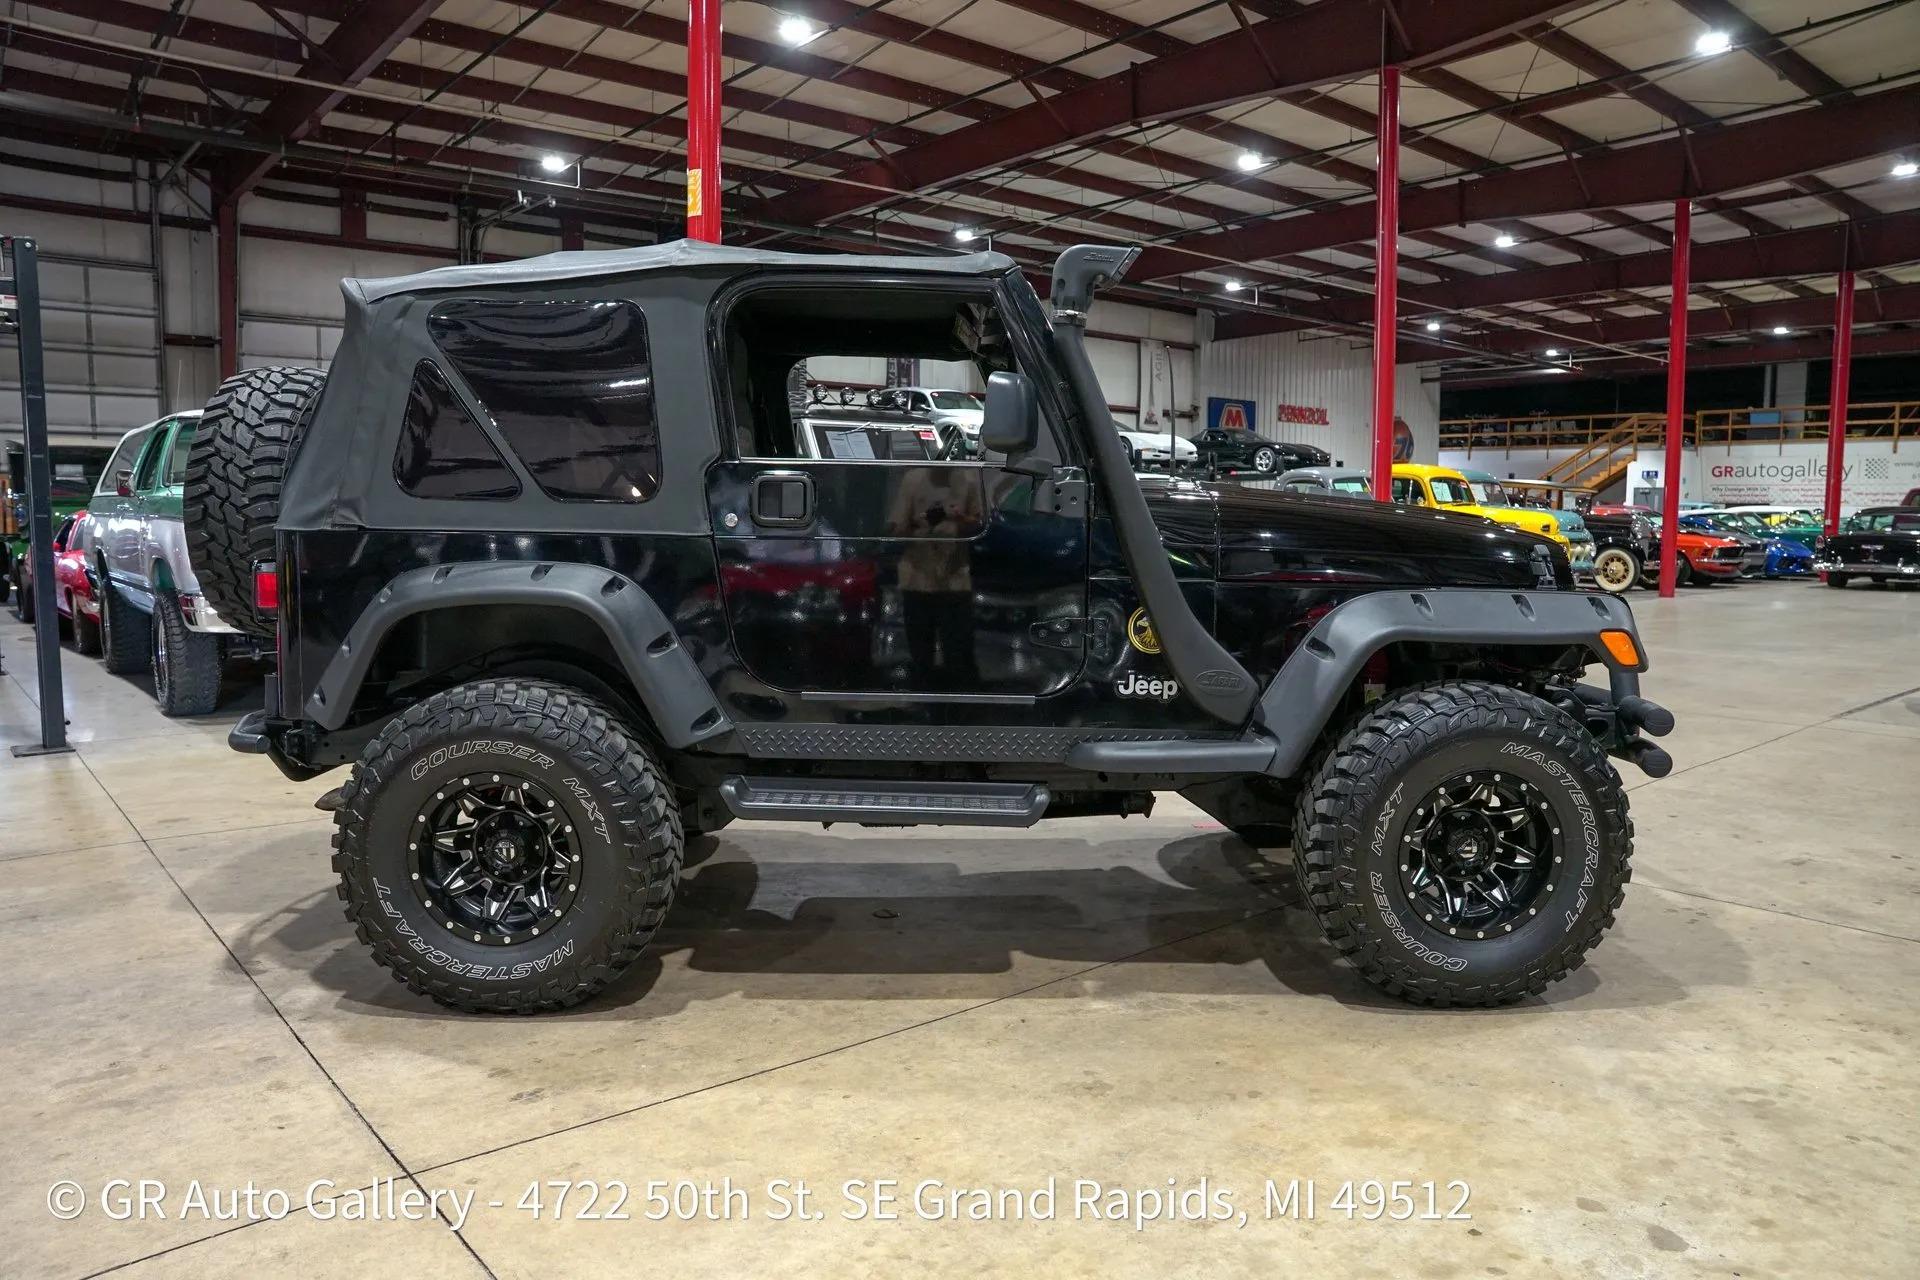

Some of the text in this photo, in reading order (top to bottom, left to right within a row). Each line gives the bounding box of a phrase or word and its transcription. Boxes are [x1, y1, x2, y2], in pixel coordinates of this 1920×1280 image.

[1224, 408, 1244, 427] M
[1711, 458, 1853, 483] GRautogalley
[1117, 671, 1178, 699] Jeep
[411, 740, 611, 844] COURSER MXT
[1501, 741, 1600, 932] MASTERCRAFT
[373, 877, 574, 980] MASTERCRAFT
[1371, 782, 1468, 972] COURSER MXT
